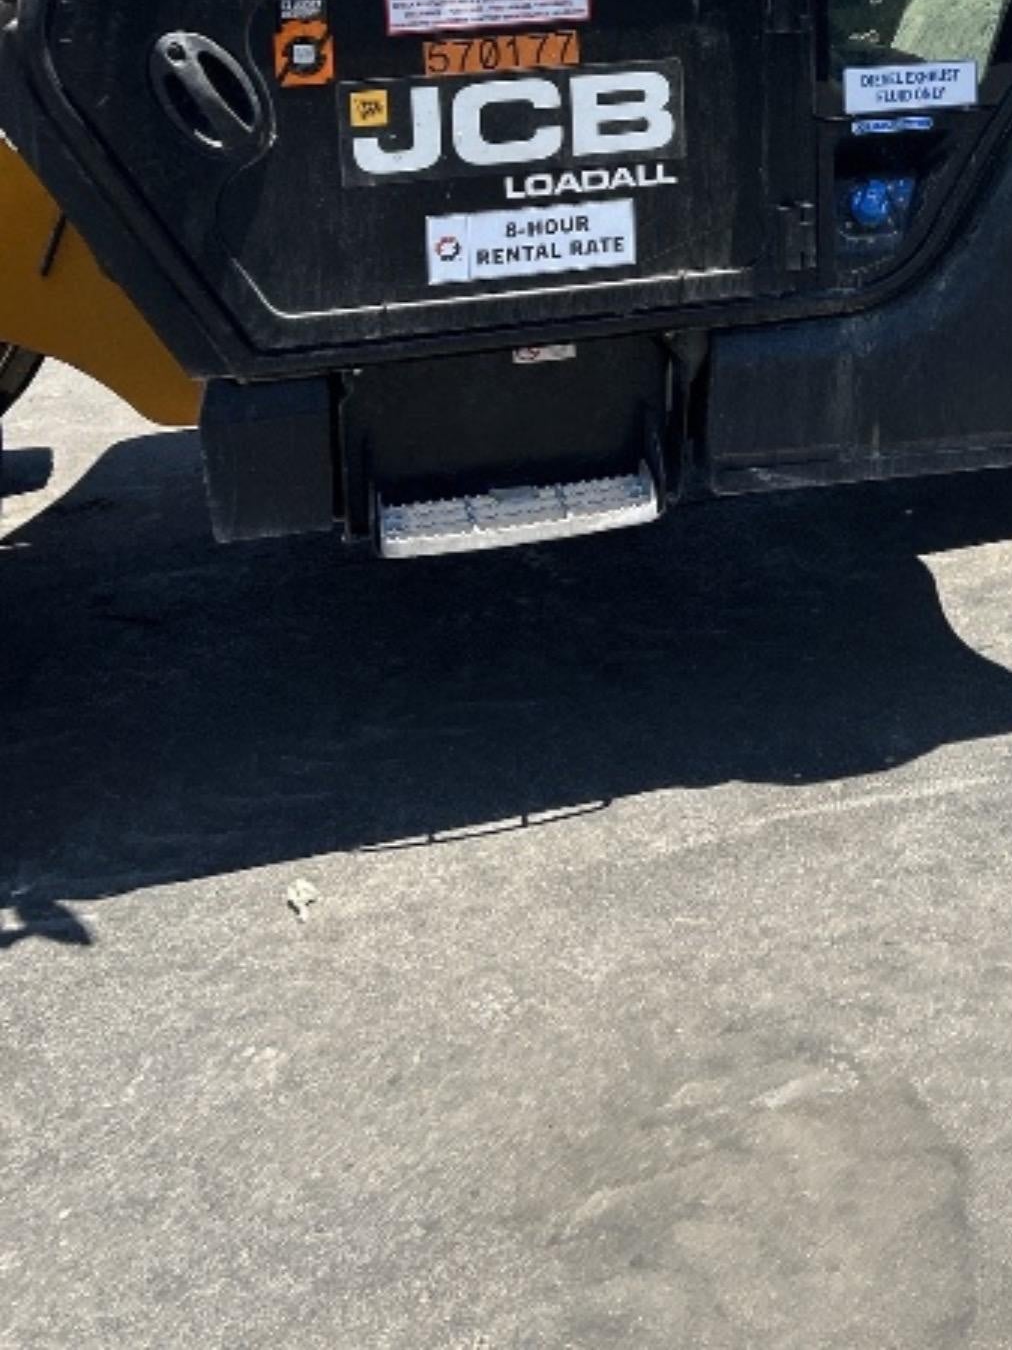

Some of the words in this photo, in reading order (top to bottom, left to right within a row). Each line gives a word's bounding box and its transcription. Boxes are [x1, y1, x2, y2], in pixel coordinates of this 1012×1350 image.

[427, 31, 575, 74] 570177
[352, 71, 676, 175] JCB
[504, 163, 678, 200] LOADALL
[506, 215, 590, 238] 8-HOUR
[476, 243, 561, 266] RENTAL
[569, 236, 625, 257] RATE
